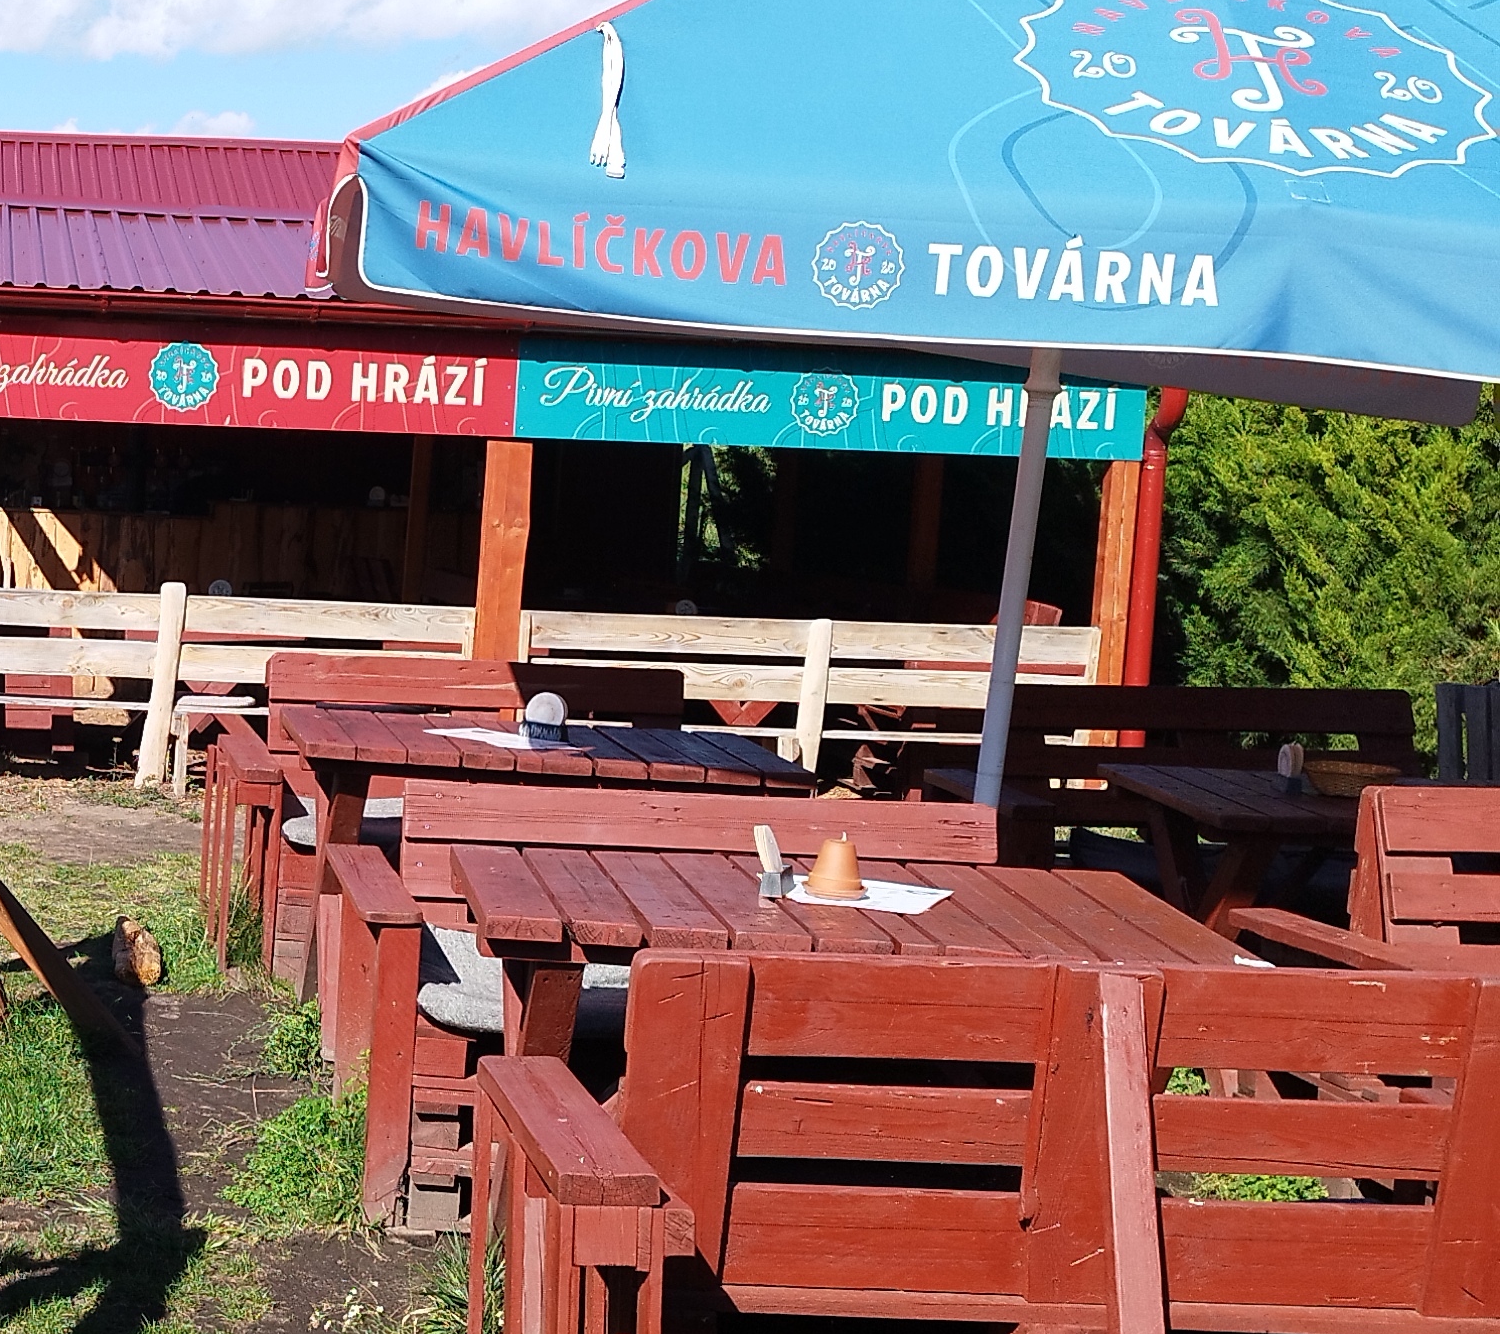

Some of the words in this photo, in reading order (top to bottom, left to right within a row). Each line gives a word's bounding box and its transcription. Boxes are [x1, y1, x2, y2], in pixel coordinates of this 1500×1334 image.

[1069, 50, 1136, 79] 20
[1374, 71, 1442, 104] 20
[1103, 91, 1448, 160] TOVÁRNA
[415, 200, 787, 286] HAVLÍČKOVA
[928, 234, 1219, 306] TOVÁRNA
[823, 274, 890, 303] TOVÁRNA
[242, 357, 332, 400] POD
[351, 355, 488, 406] HRÁZÍ
[539, 365, 641, 407] Pivní
[630, 378, 772, 423] zahrádka
[881, 383, 969, 425] POD
